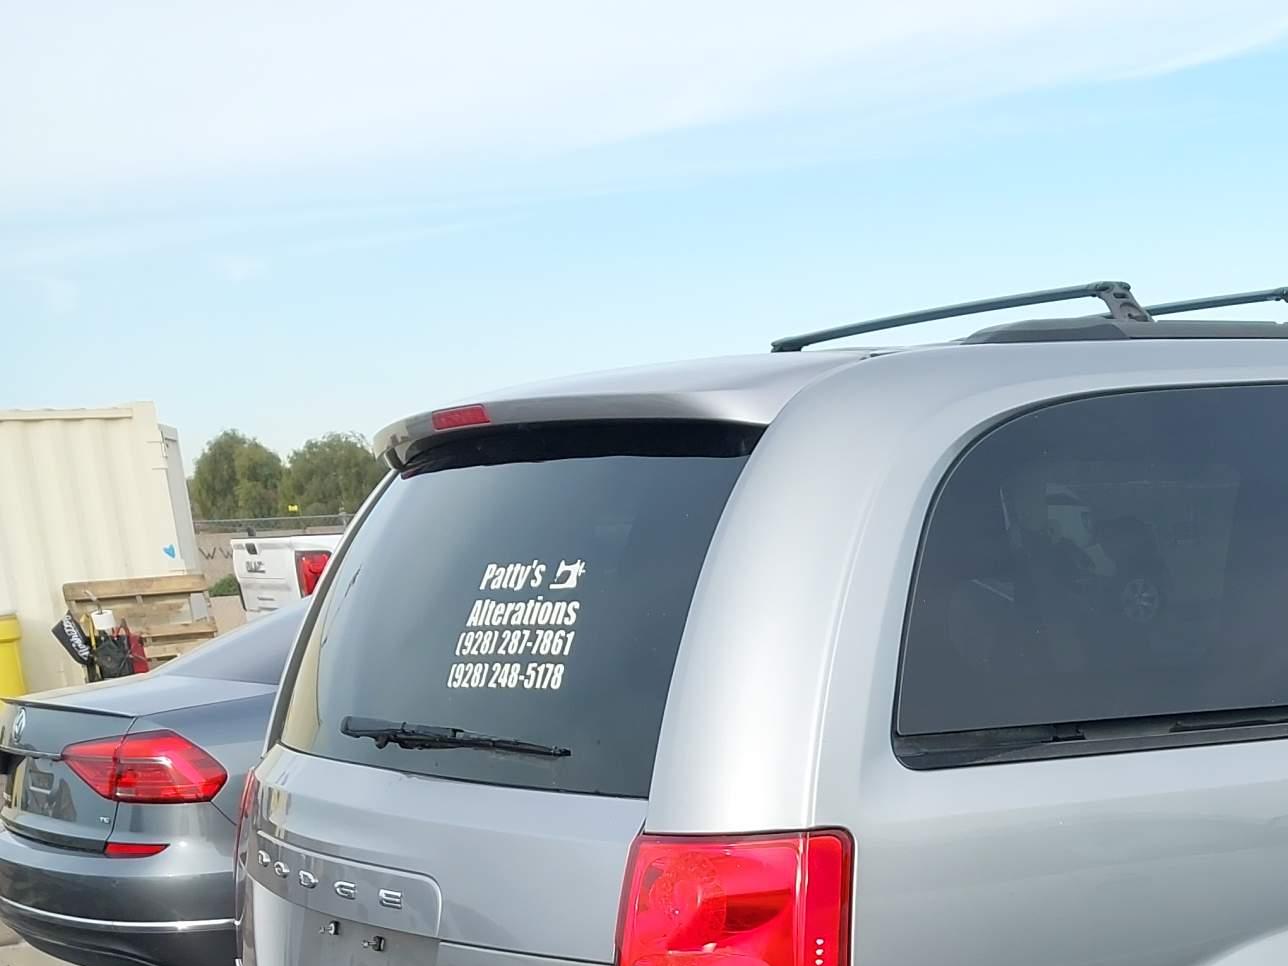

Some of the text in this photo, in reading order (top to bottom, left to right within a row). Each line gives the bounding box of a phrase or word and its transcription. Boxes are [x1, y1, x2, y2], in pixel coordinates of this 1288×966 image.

[480, 560, 546, 591] Patty's
[466, 596, 580, 627] Alterations
[455, 629, 575, 656] (928) 287-7861
[447, 662, 565, 689] (928) 248-5178
[258, 850, 403, 910] DODGE
